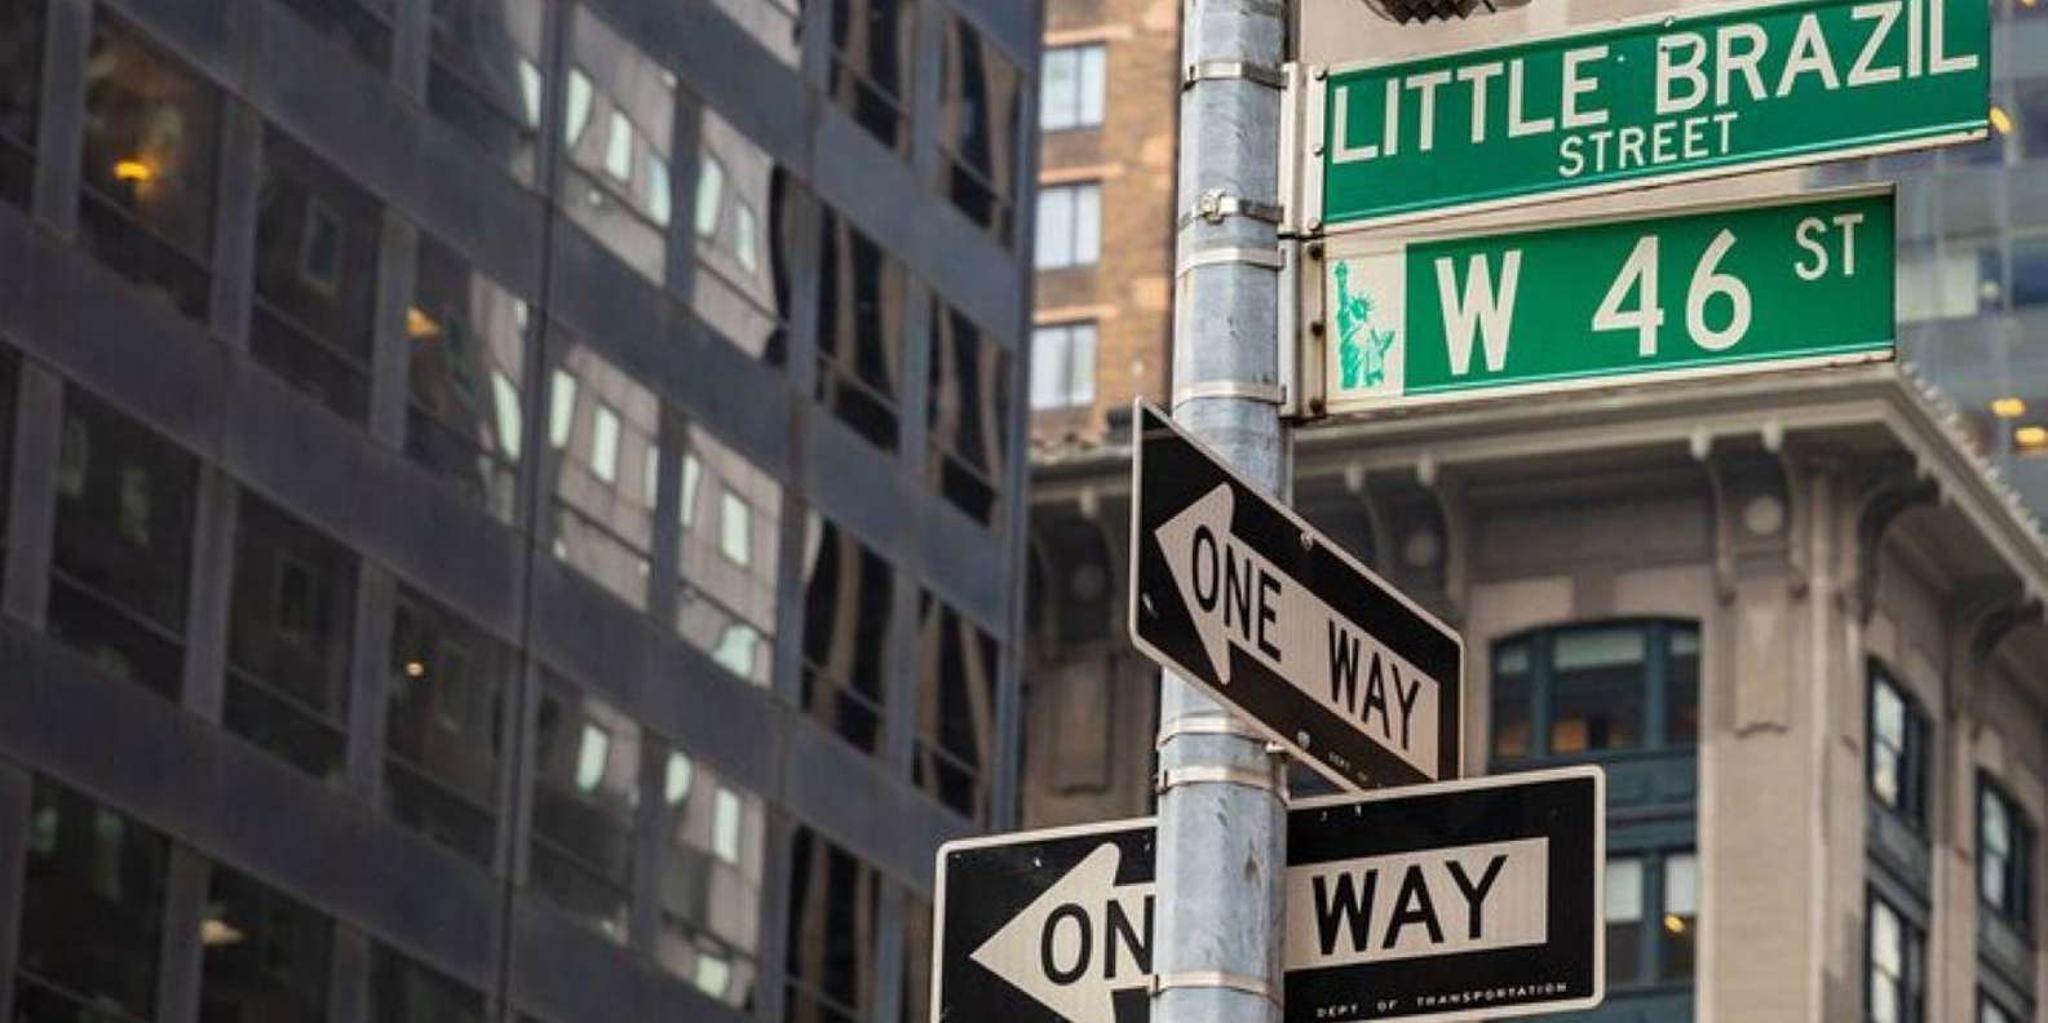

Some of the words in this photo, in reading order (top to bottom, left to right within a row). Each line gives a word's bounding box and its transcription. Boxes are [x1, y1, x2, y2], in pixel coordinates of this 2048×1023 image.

[1331, 45, 1609, 164] LITTLE
[1655, 0, 1979, 115] BRAZIL
[1559, 111, 1738, 177] STREET
[1434, 249, 1522, 376] W
[1592, 229, 1752, 357] 46
[1795, 213, 1863, 281] ST
[1191, 524, 1282, 663] ONE
[1328, 618, 1421, 751] WAY
[1041, 895, 1155, 986] ON
[1311, 854, 1509, 956] WAY
[1316, 1003, 1359, 1018] DEPT
[1377, 1000, 1399, 1012] OF
[1416, 982, 1568, 1007] TRANSPORTATION
